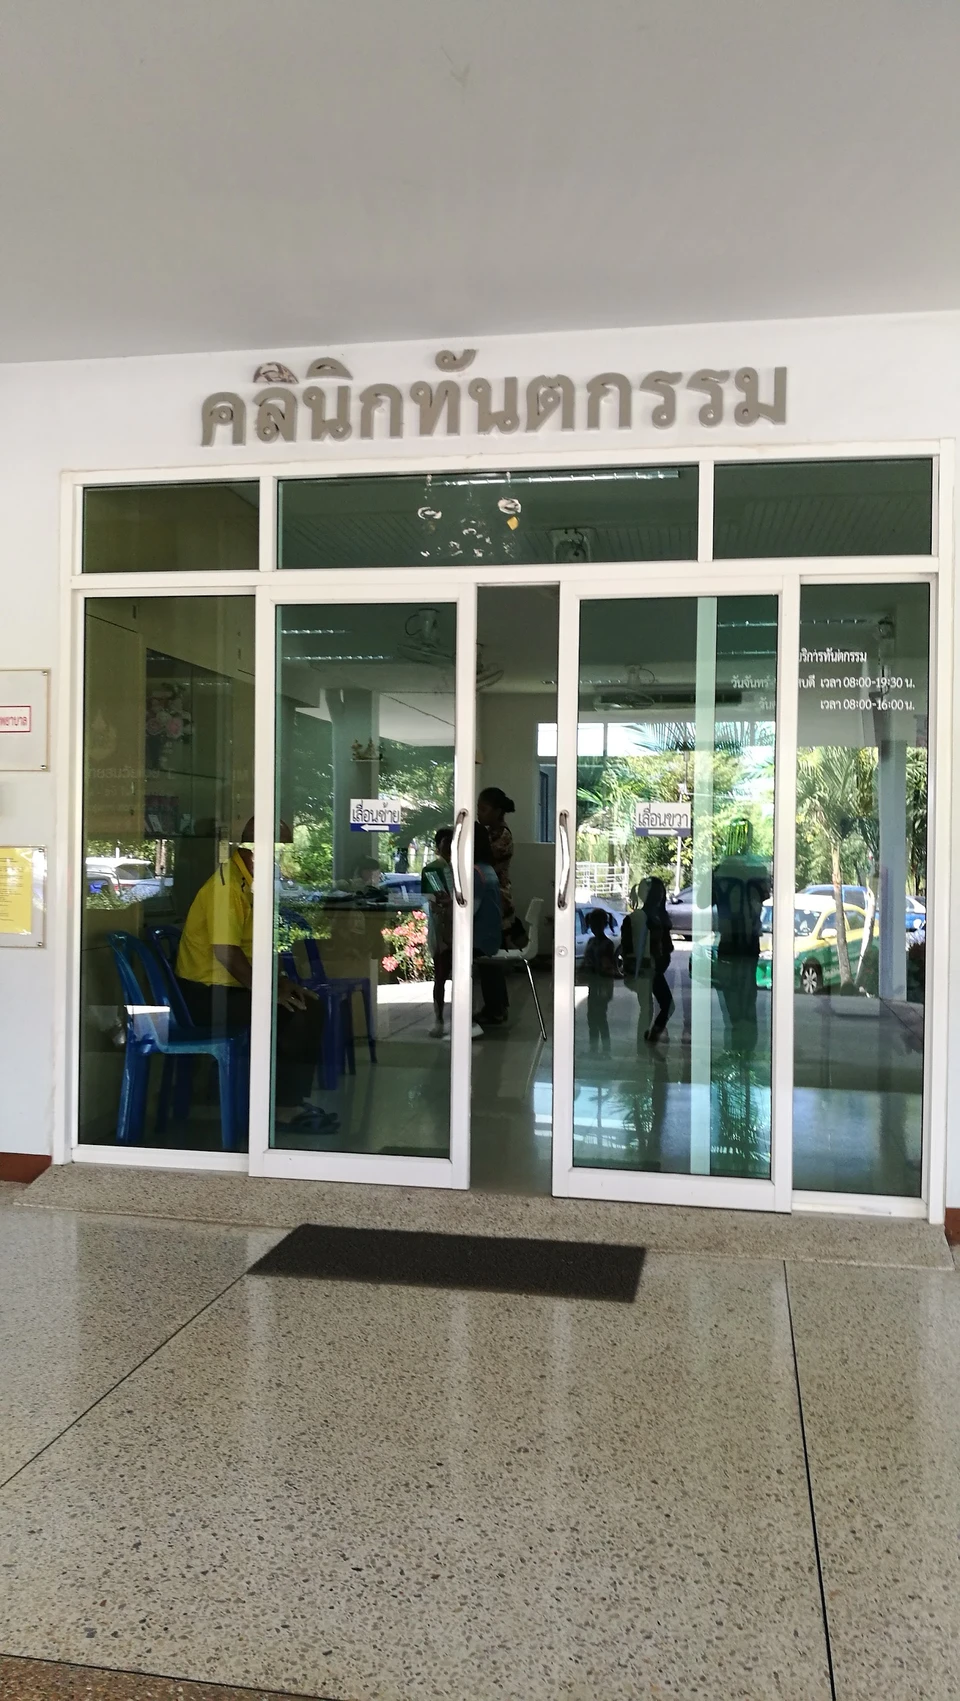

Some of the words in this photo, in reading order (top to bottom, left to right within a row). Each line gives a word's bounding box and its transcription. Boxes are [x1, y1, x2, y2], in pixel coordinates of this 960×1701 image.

[200, 348, 788, 448] คลินิกทันตกรรม
[820, 678, 842, 689] เวลา
[843, 676, 903, 688] 08:00-19:30
[905, 678, 916, 689] น.
[820, 700, 842, 710] เวลา
[843, 698, 904, 710] 08:00-16:00
[905, 700, 915, 710] น.
[0, 716, 28, 727] พยาบาล
[638, 803, 689, 827] เลื่อนขวา
